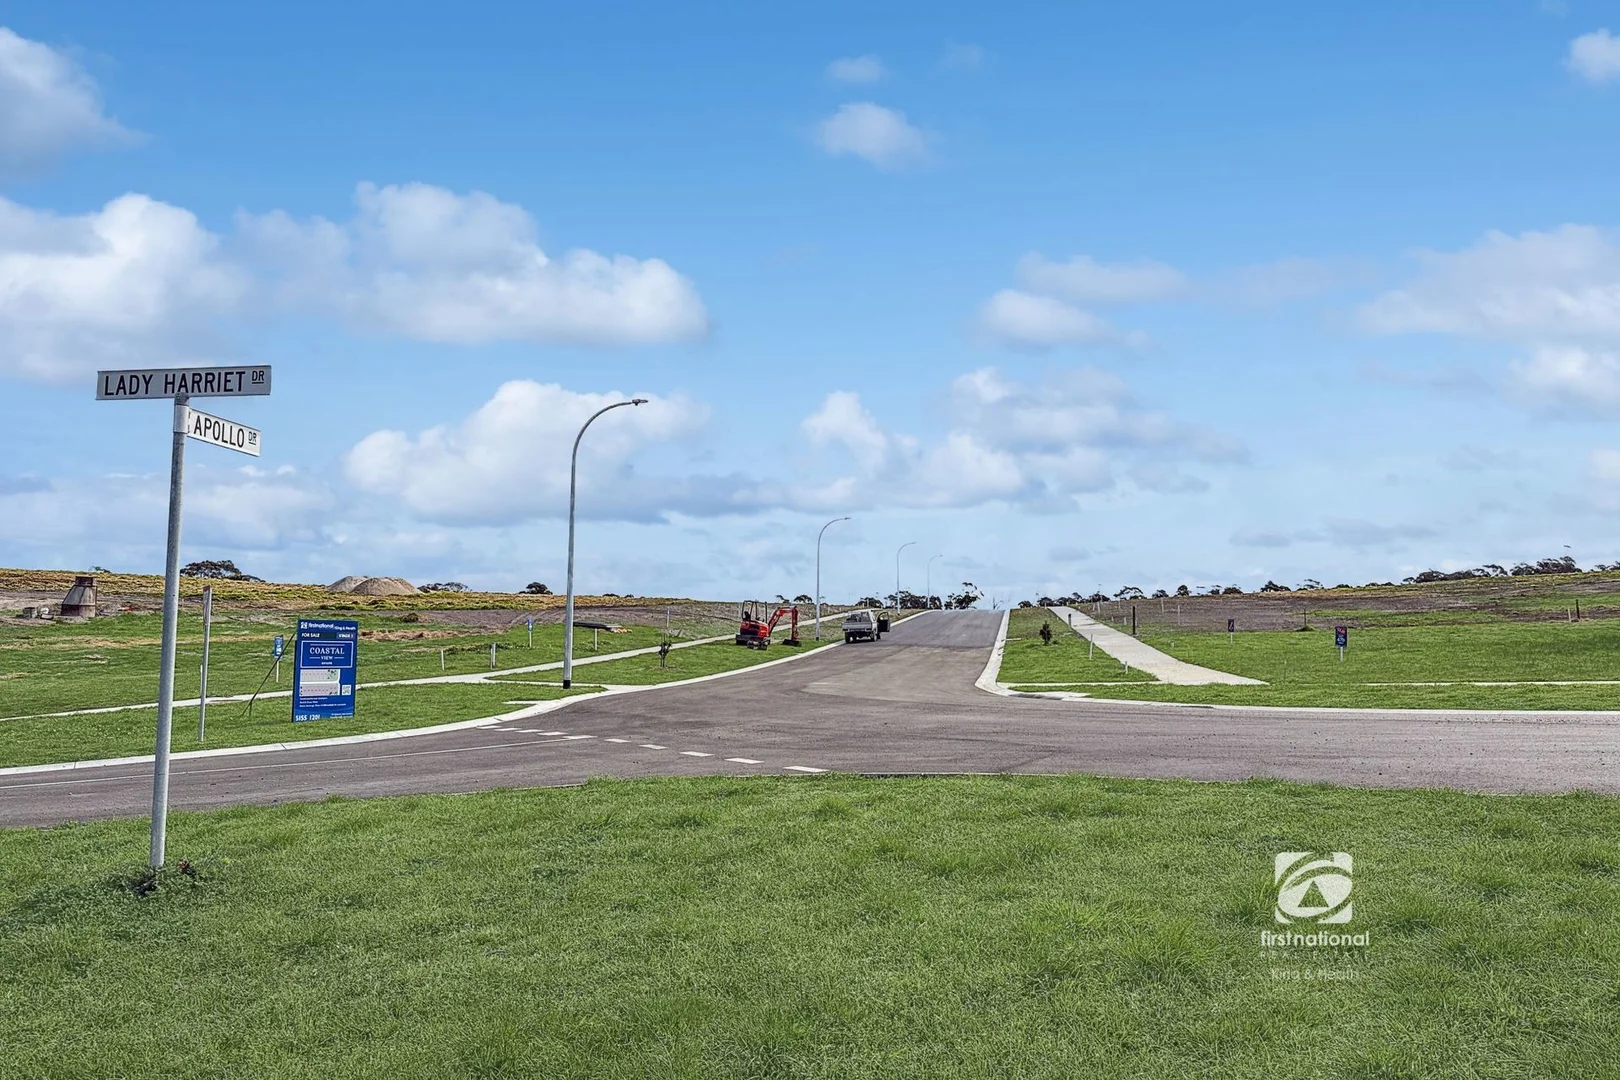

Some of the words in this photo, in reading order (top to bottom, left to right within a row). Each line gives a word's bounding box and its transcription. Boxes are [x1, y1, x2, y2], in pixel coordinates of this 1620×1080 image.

[104, 374, 153, 396] LADY
[164, 371, 246, 394] HARRIET
[251, 370, 265, 384] DR
[193, 415, 245, 448] APOLLO
[248, 431, 257, 445] DR
[309, 647, 345, 655] COASTAL
